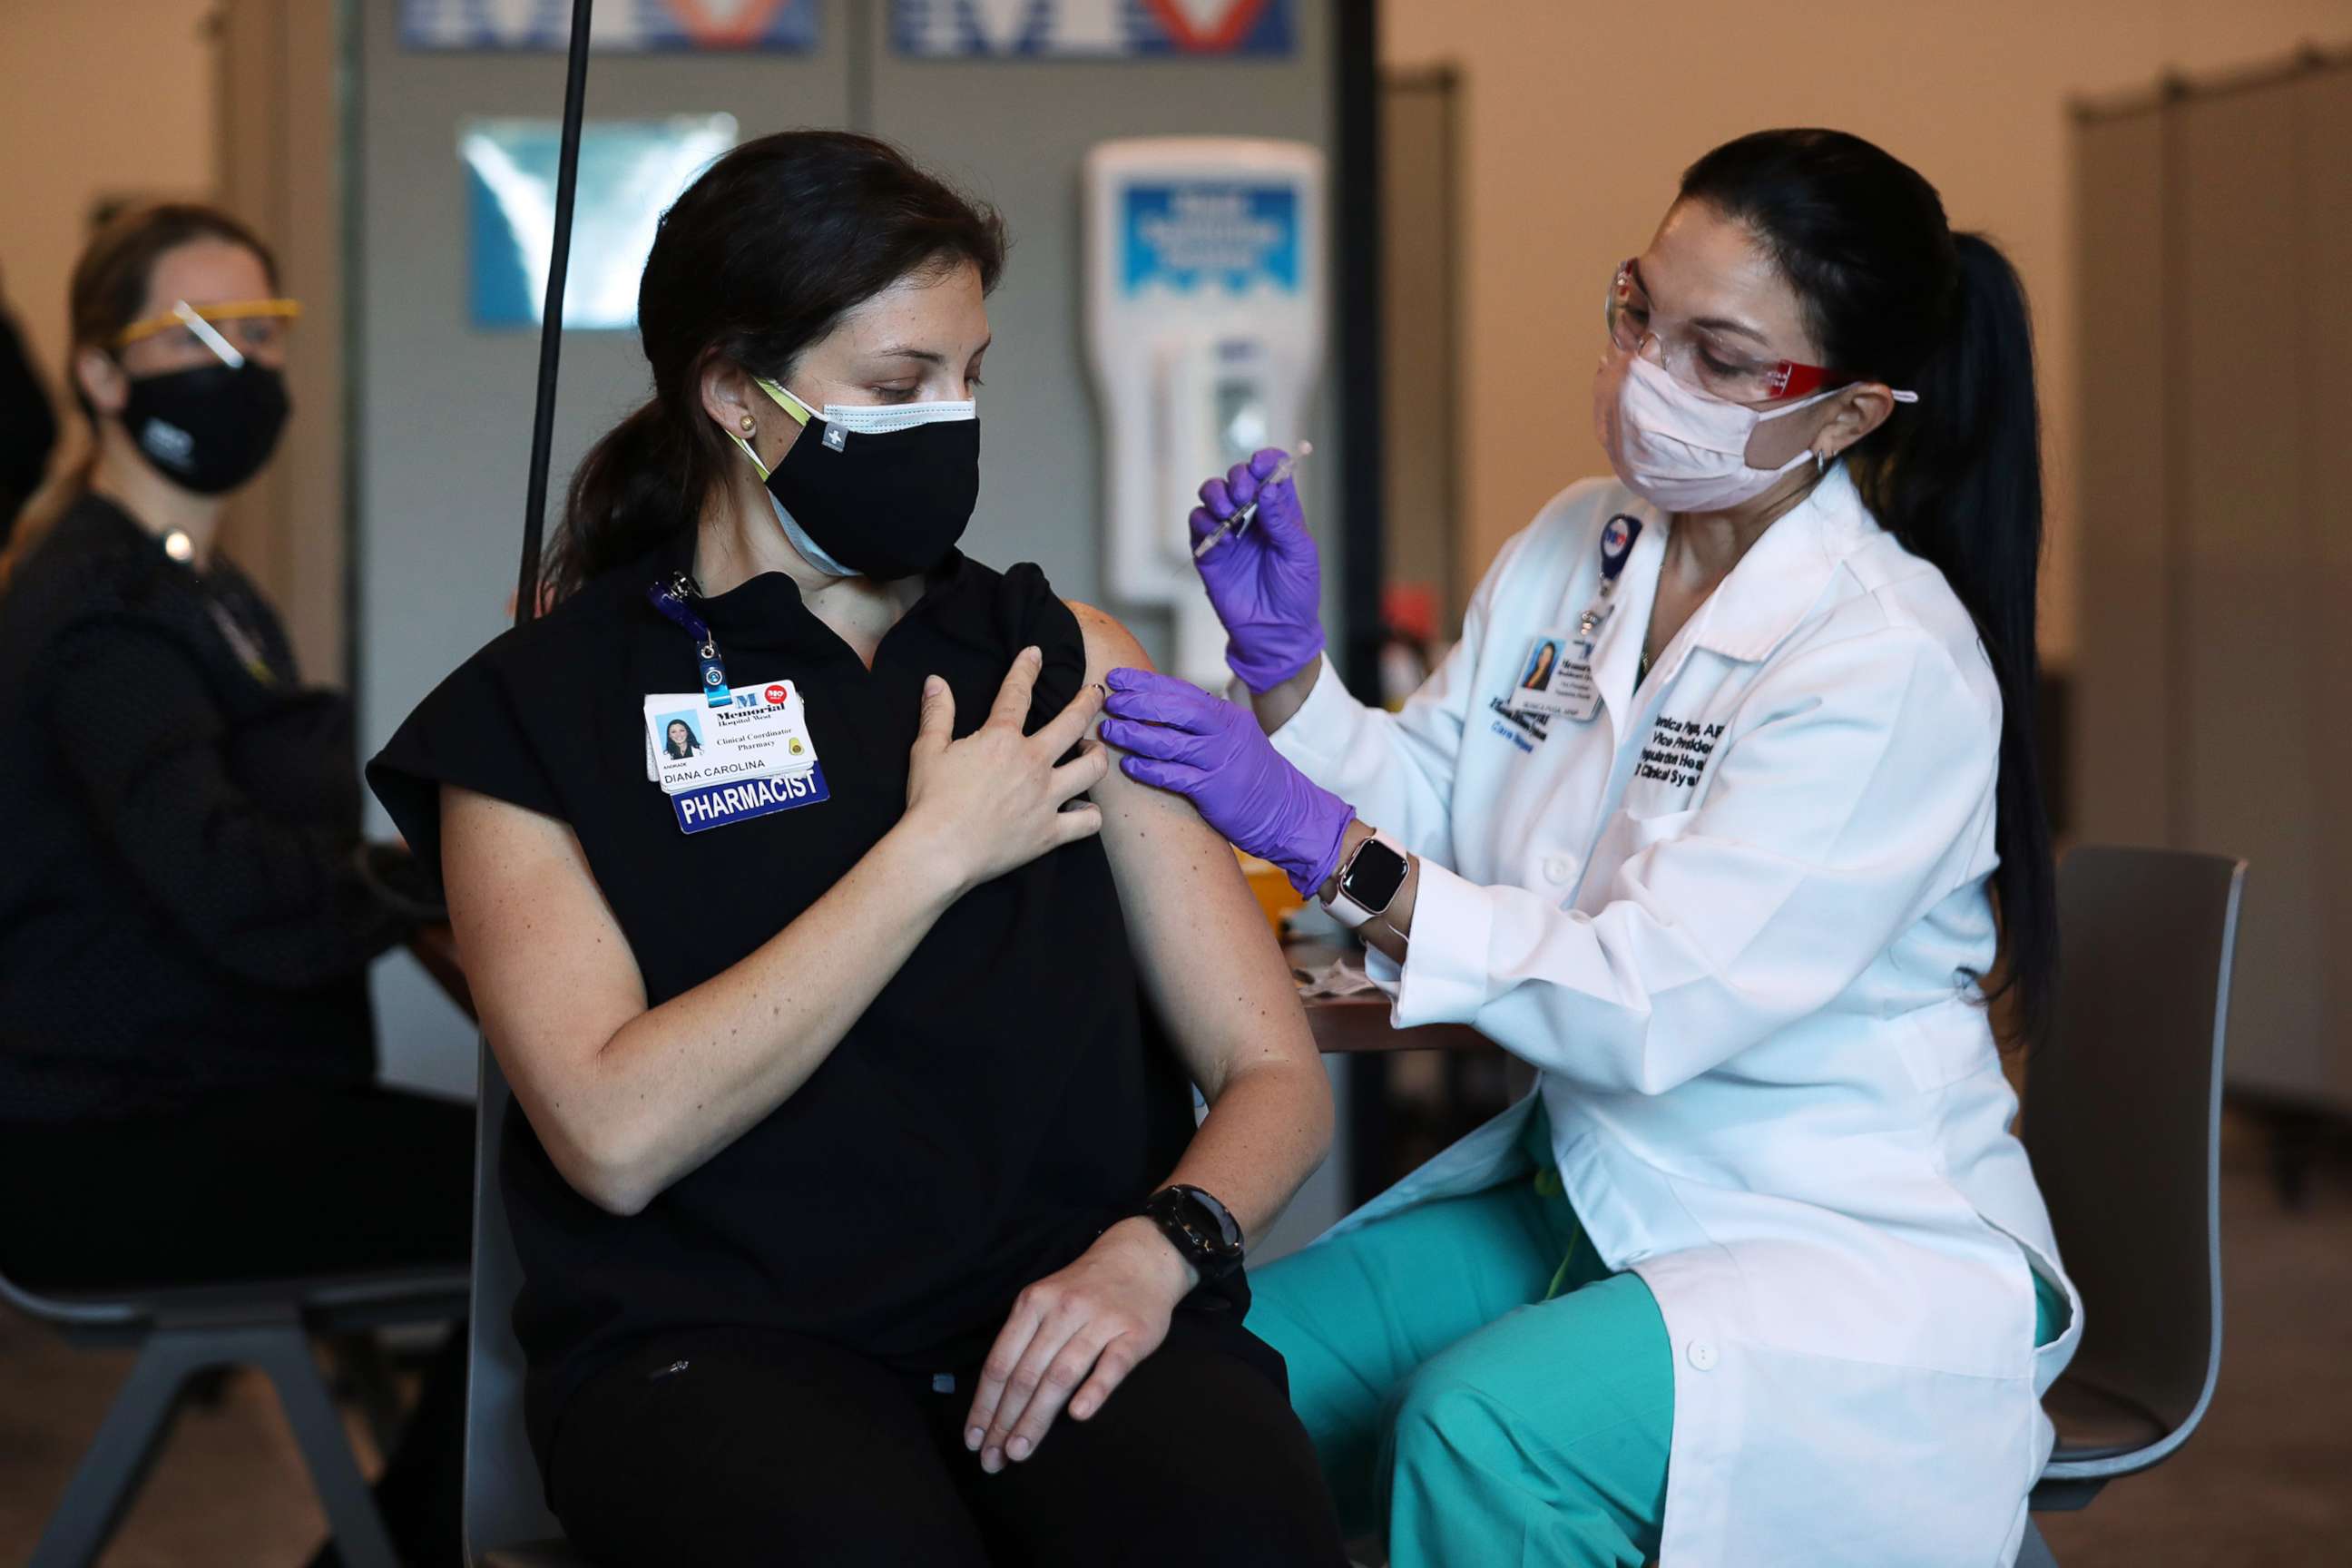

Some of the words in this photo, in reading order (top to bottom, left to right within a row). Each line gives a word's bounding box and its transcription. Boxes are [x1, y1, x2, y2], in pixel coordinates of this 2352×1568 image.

[717, 702, 786, 720] Memorial
[718, 717, 750, 727] Hospital
[716, 736, 745, 746] Clinical
[747, 728, 792, 740] Coordinator
[738, 740, 775, 751] Pharmacy
[664, 769, 701, 784] DIANA
[703, 760, 766, 777] CAROLINA
[681, 769, 817, 825] PHARMACIST
